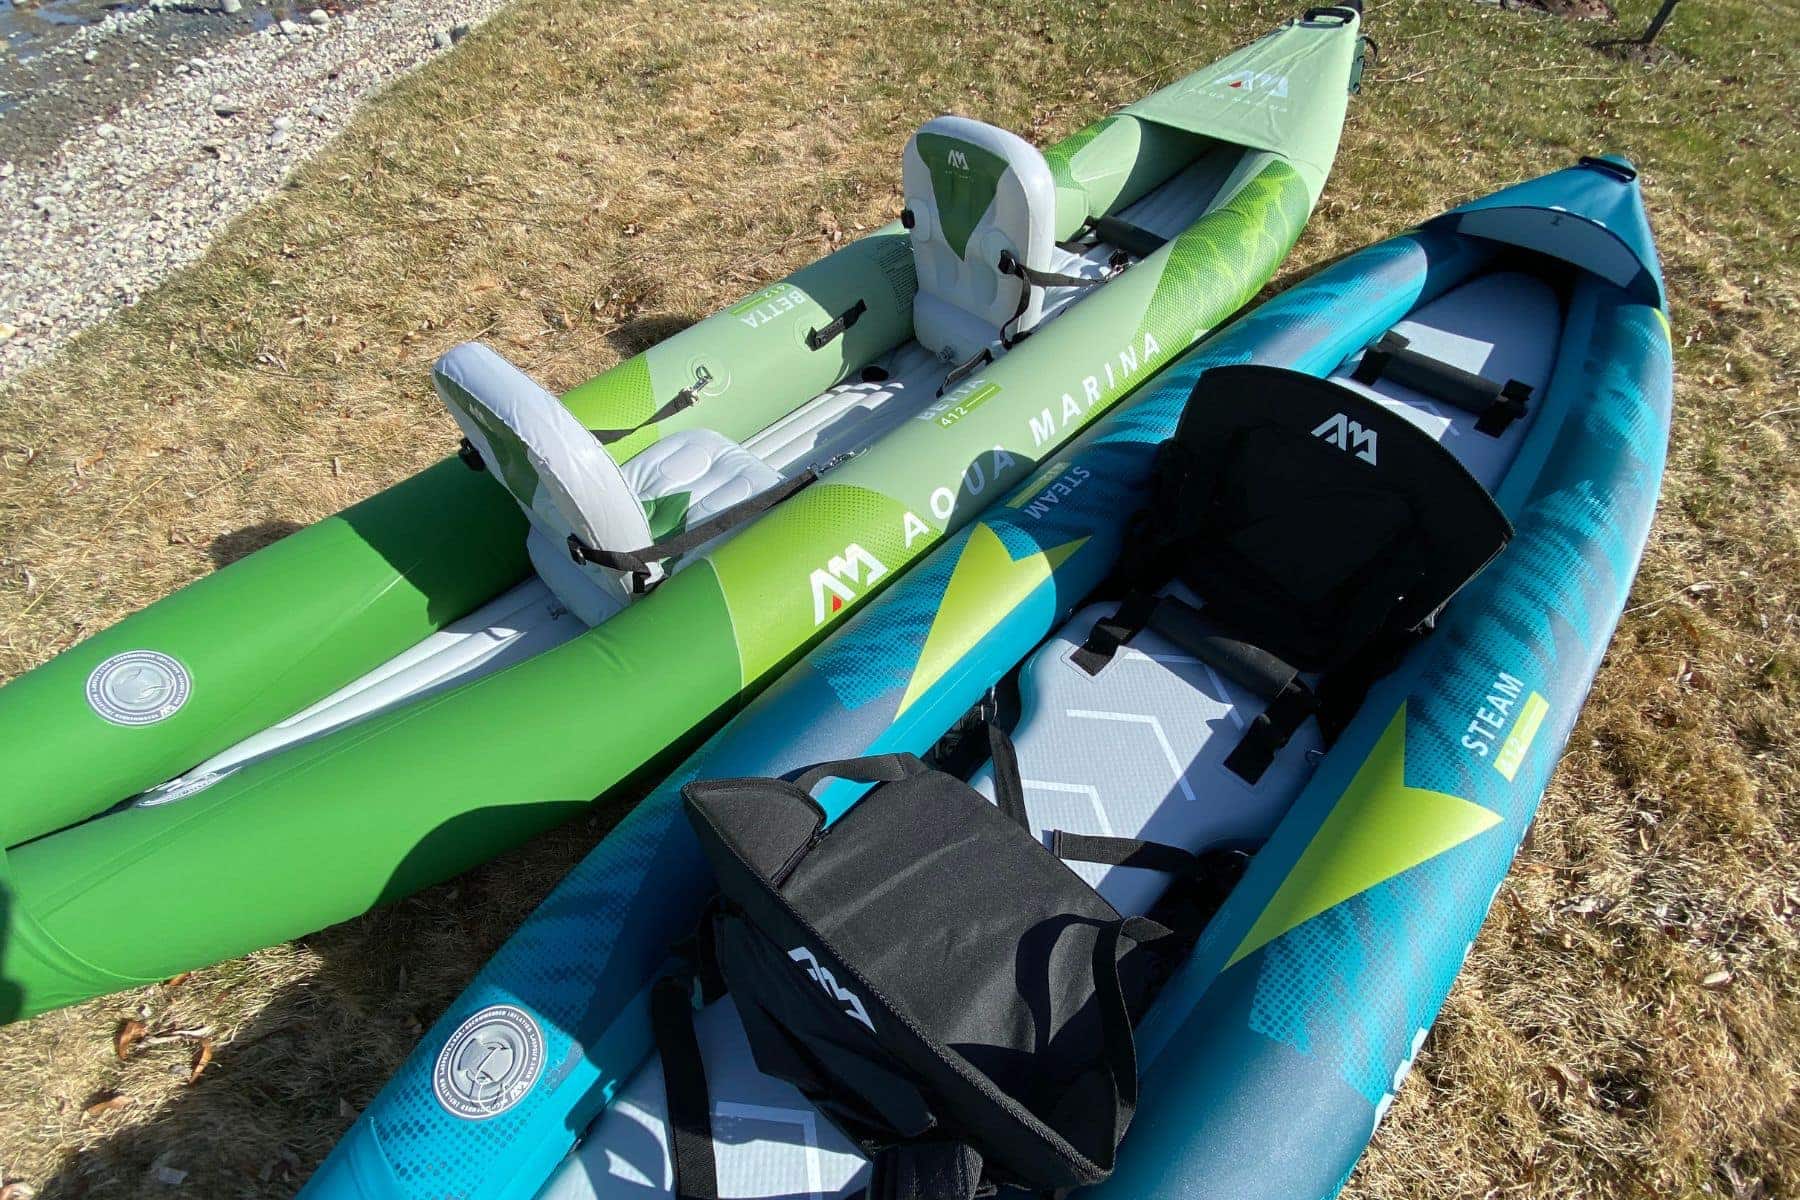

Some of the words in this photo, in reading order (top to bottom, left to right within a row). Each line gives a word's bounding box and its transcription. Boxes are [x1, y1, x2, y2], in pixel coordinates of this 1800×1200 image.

[741, 290, 806, 329] BETTA
[941, 406, 968, 427] 412
[1311, 412, 1377, 466] AM
[809, 542, 888, 626] AM
[902, 445, 1017, 548] AQUA
[1028, 332, 1160, 448] MARINA
[1023, 466, 1090, 520] STEAM
[1461, 671, 1525, 757] STEAM
